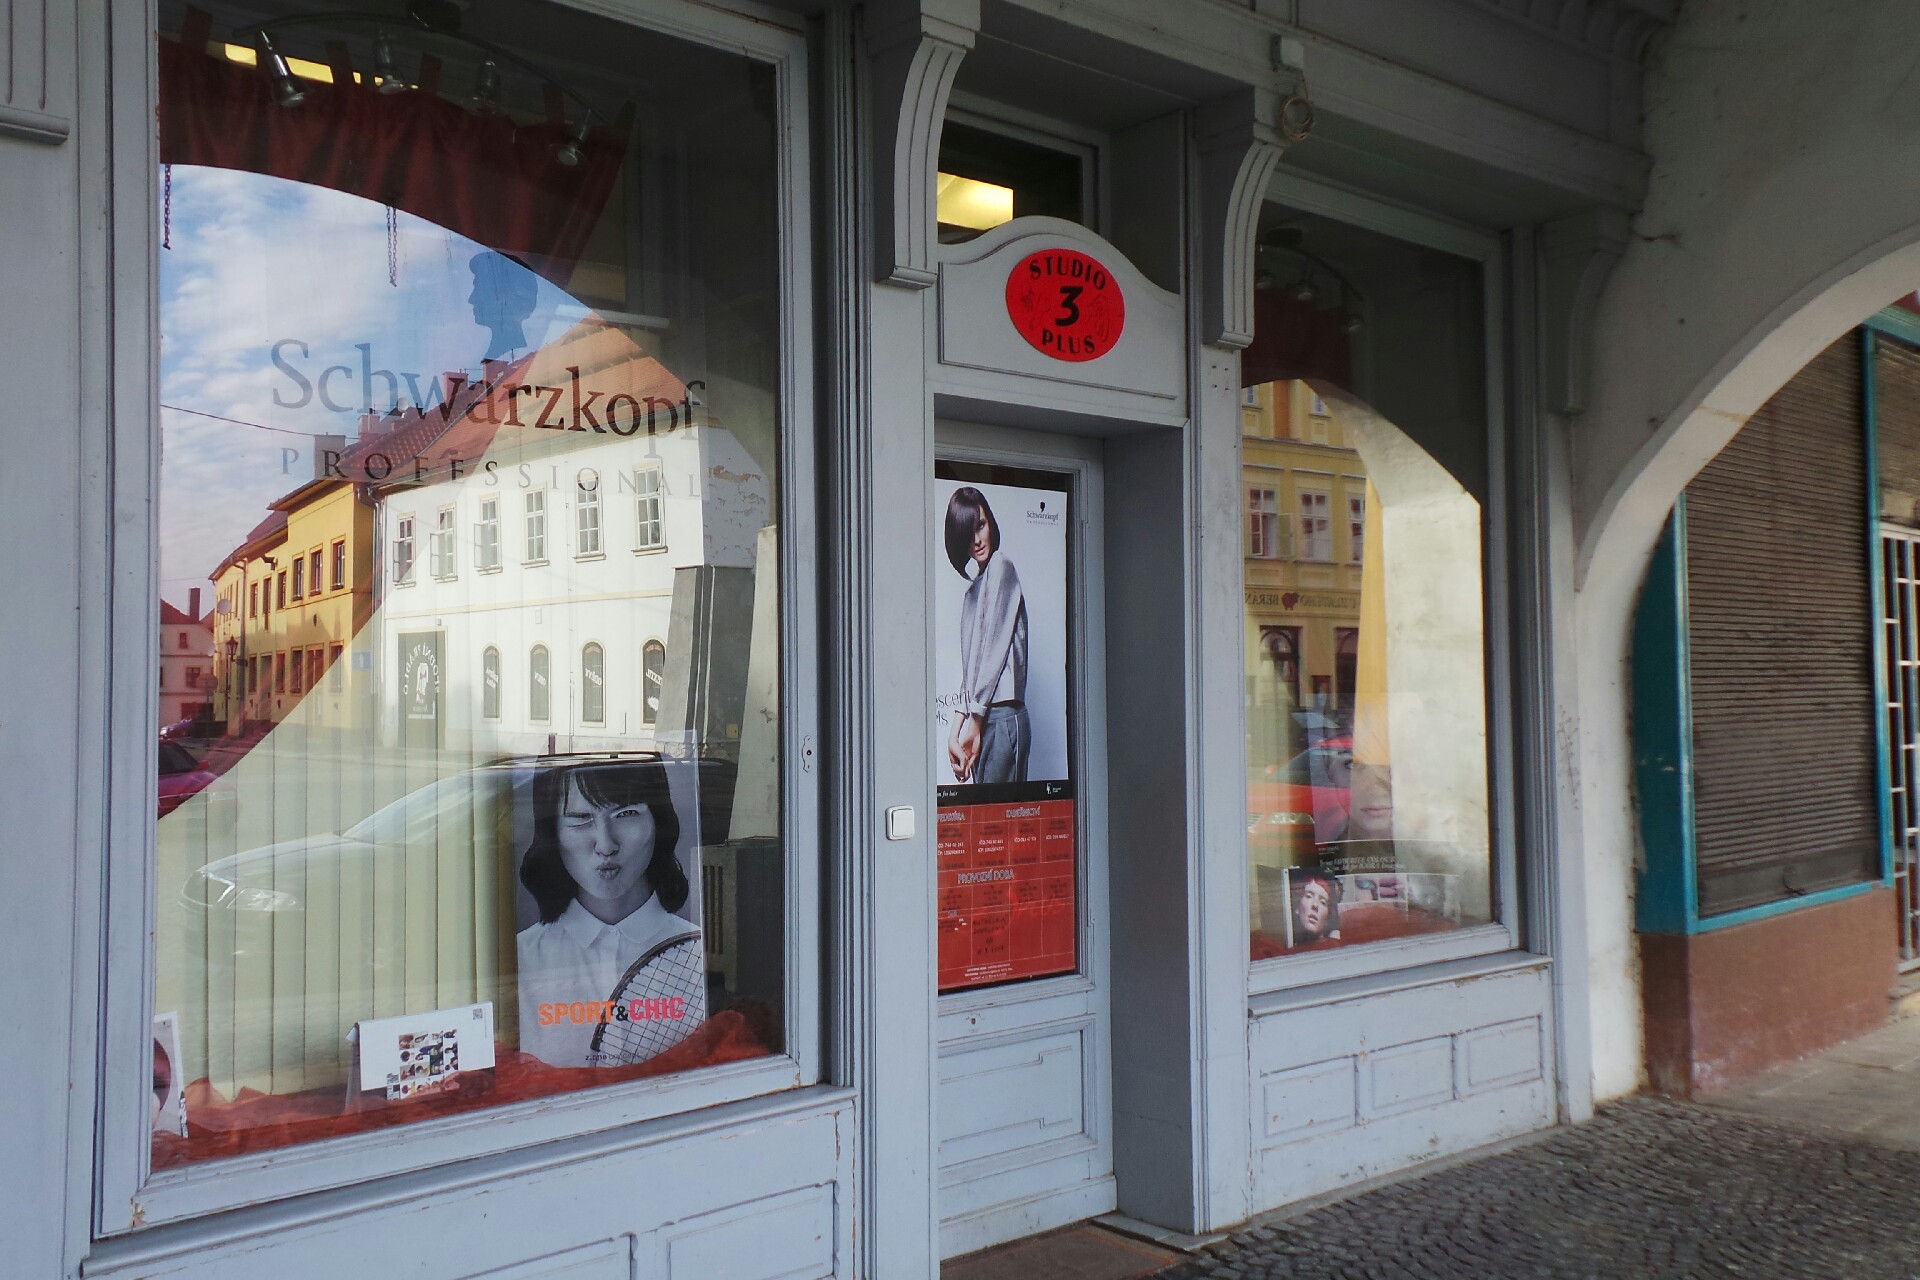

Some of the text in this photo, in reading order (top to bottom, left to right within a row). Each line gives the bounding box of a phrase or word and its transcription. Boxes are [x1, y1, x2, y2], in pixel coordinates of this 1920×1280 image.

[1029, 256, 1106, 290] STUDIO
[1055, 286, 1084, 327] 3
[1042, 328, 1095, 354] PLUS
[271, 338, 706, 459] Schwarzkopf
[281, 446, 702, 498] PROFESSIONAL
